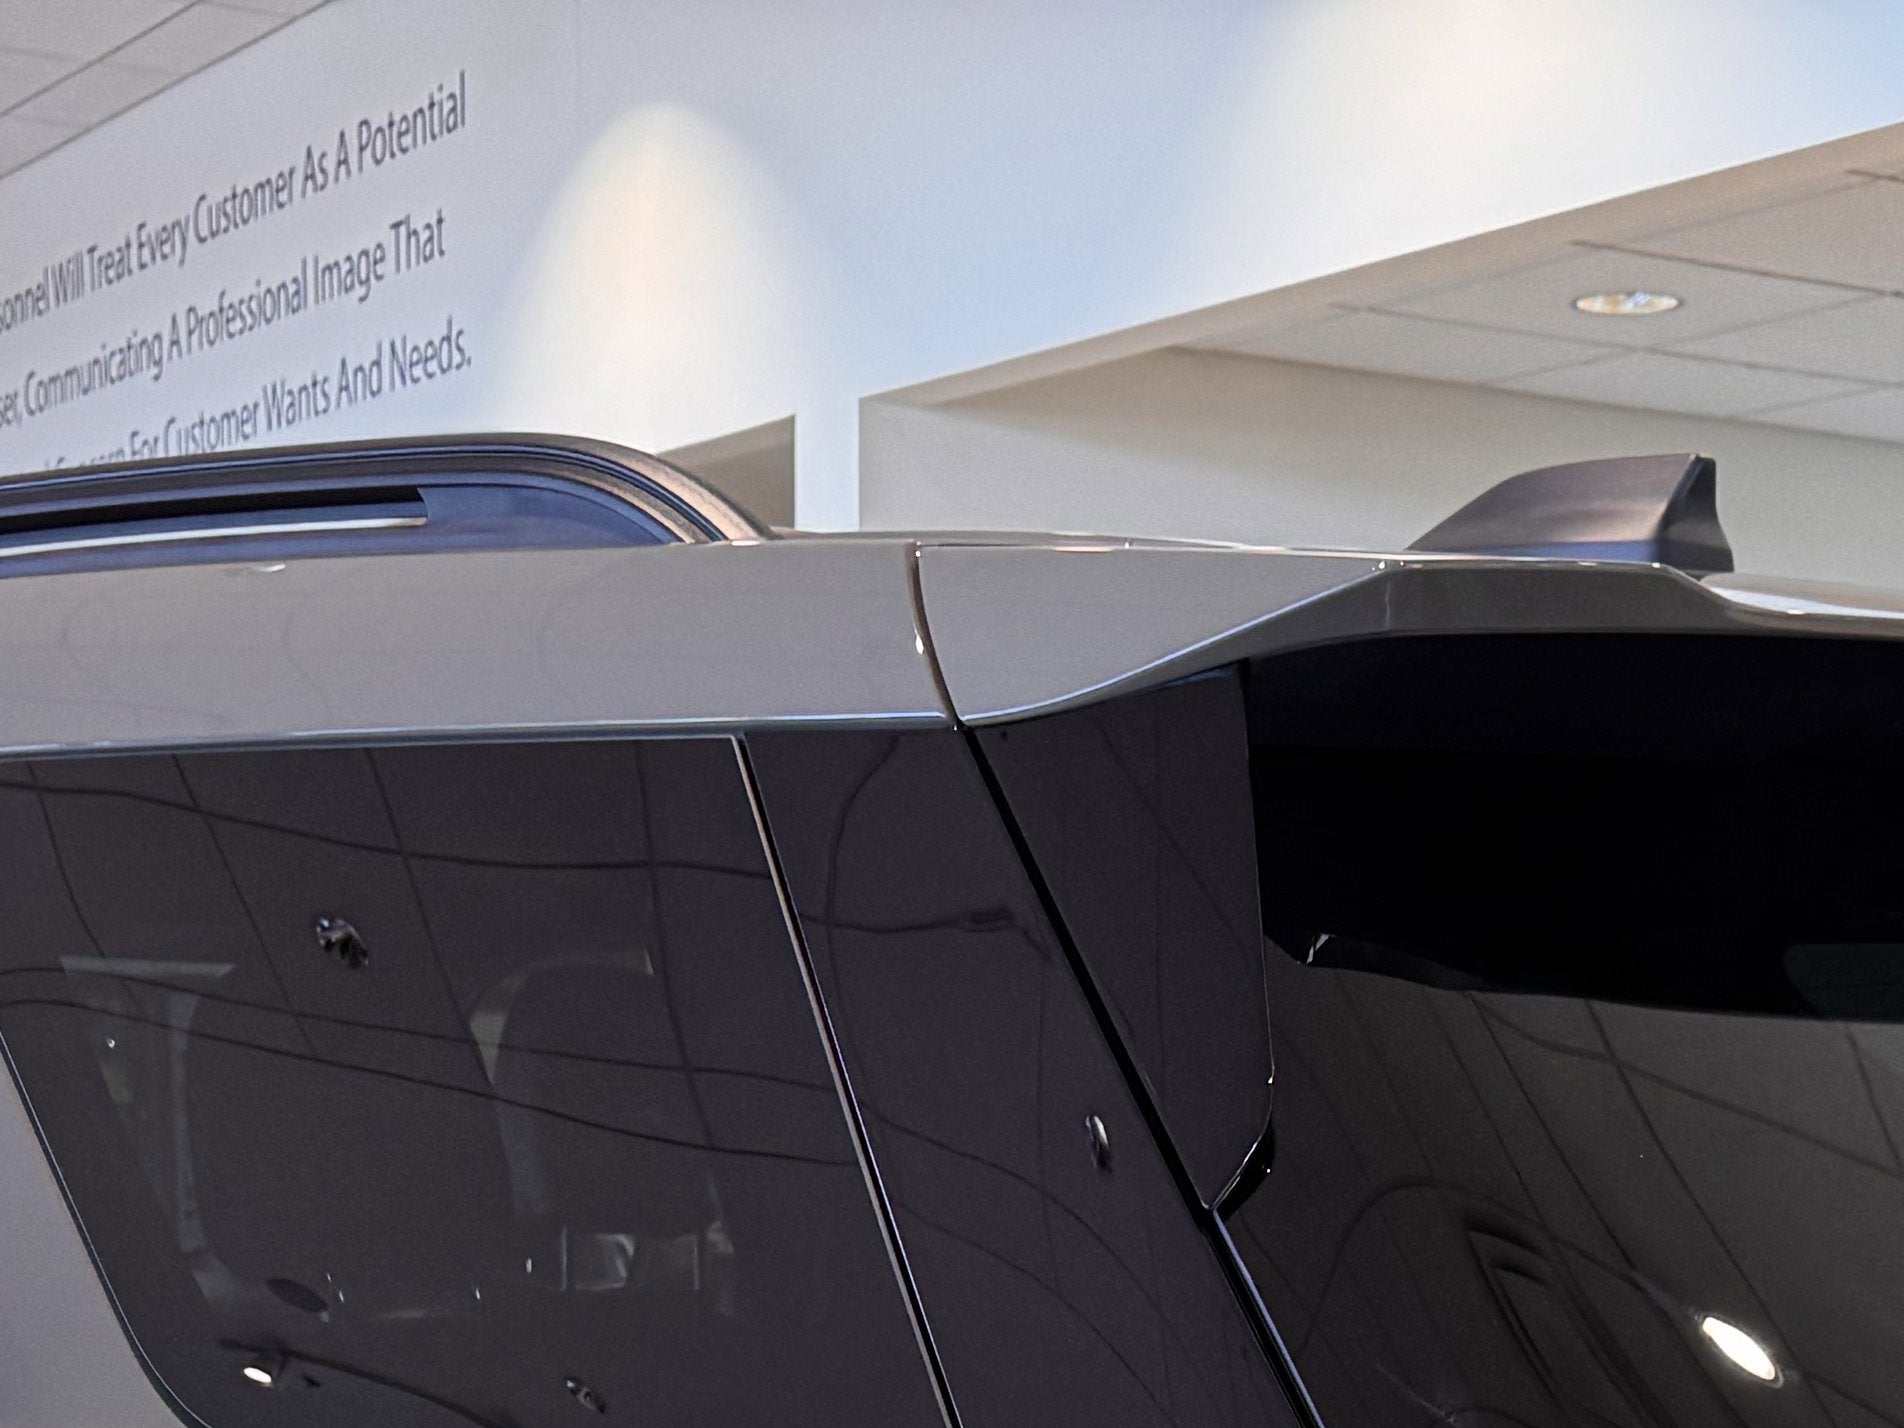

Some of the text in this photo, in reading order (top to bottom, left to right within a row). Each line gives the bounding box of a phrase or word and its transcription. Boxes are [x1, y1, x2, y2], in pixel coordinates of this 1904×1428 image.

[51, 249, 84, 308] Will
[86, 232, 133, 292] Treat
[136, 213, 191, 271] Every
[192, 165, 296, 244] Customer
[300, 144, 329, 199] As
[334, 128, 352, 184] A
[356, 68, 466, 174] Potential
[23, 330, 164, 417] Communicating
[167, 312, 184, 361] A
[185, 256, 309, 355] Professional
[313, 241, 387, 305] Image
[389, 208, 446, 275] That
[129, 313, 473, 460] For Customer Wants And Needs.
